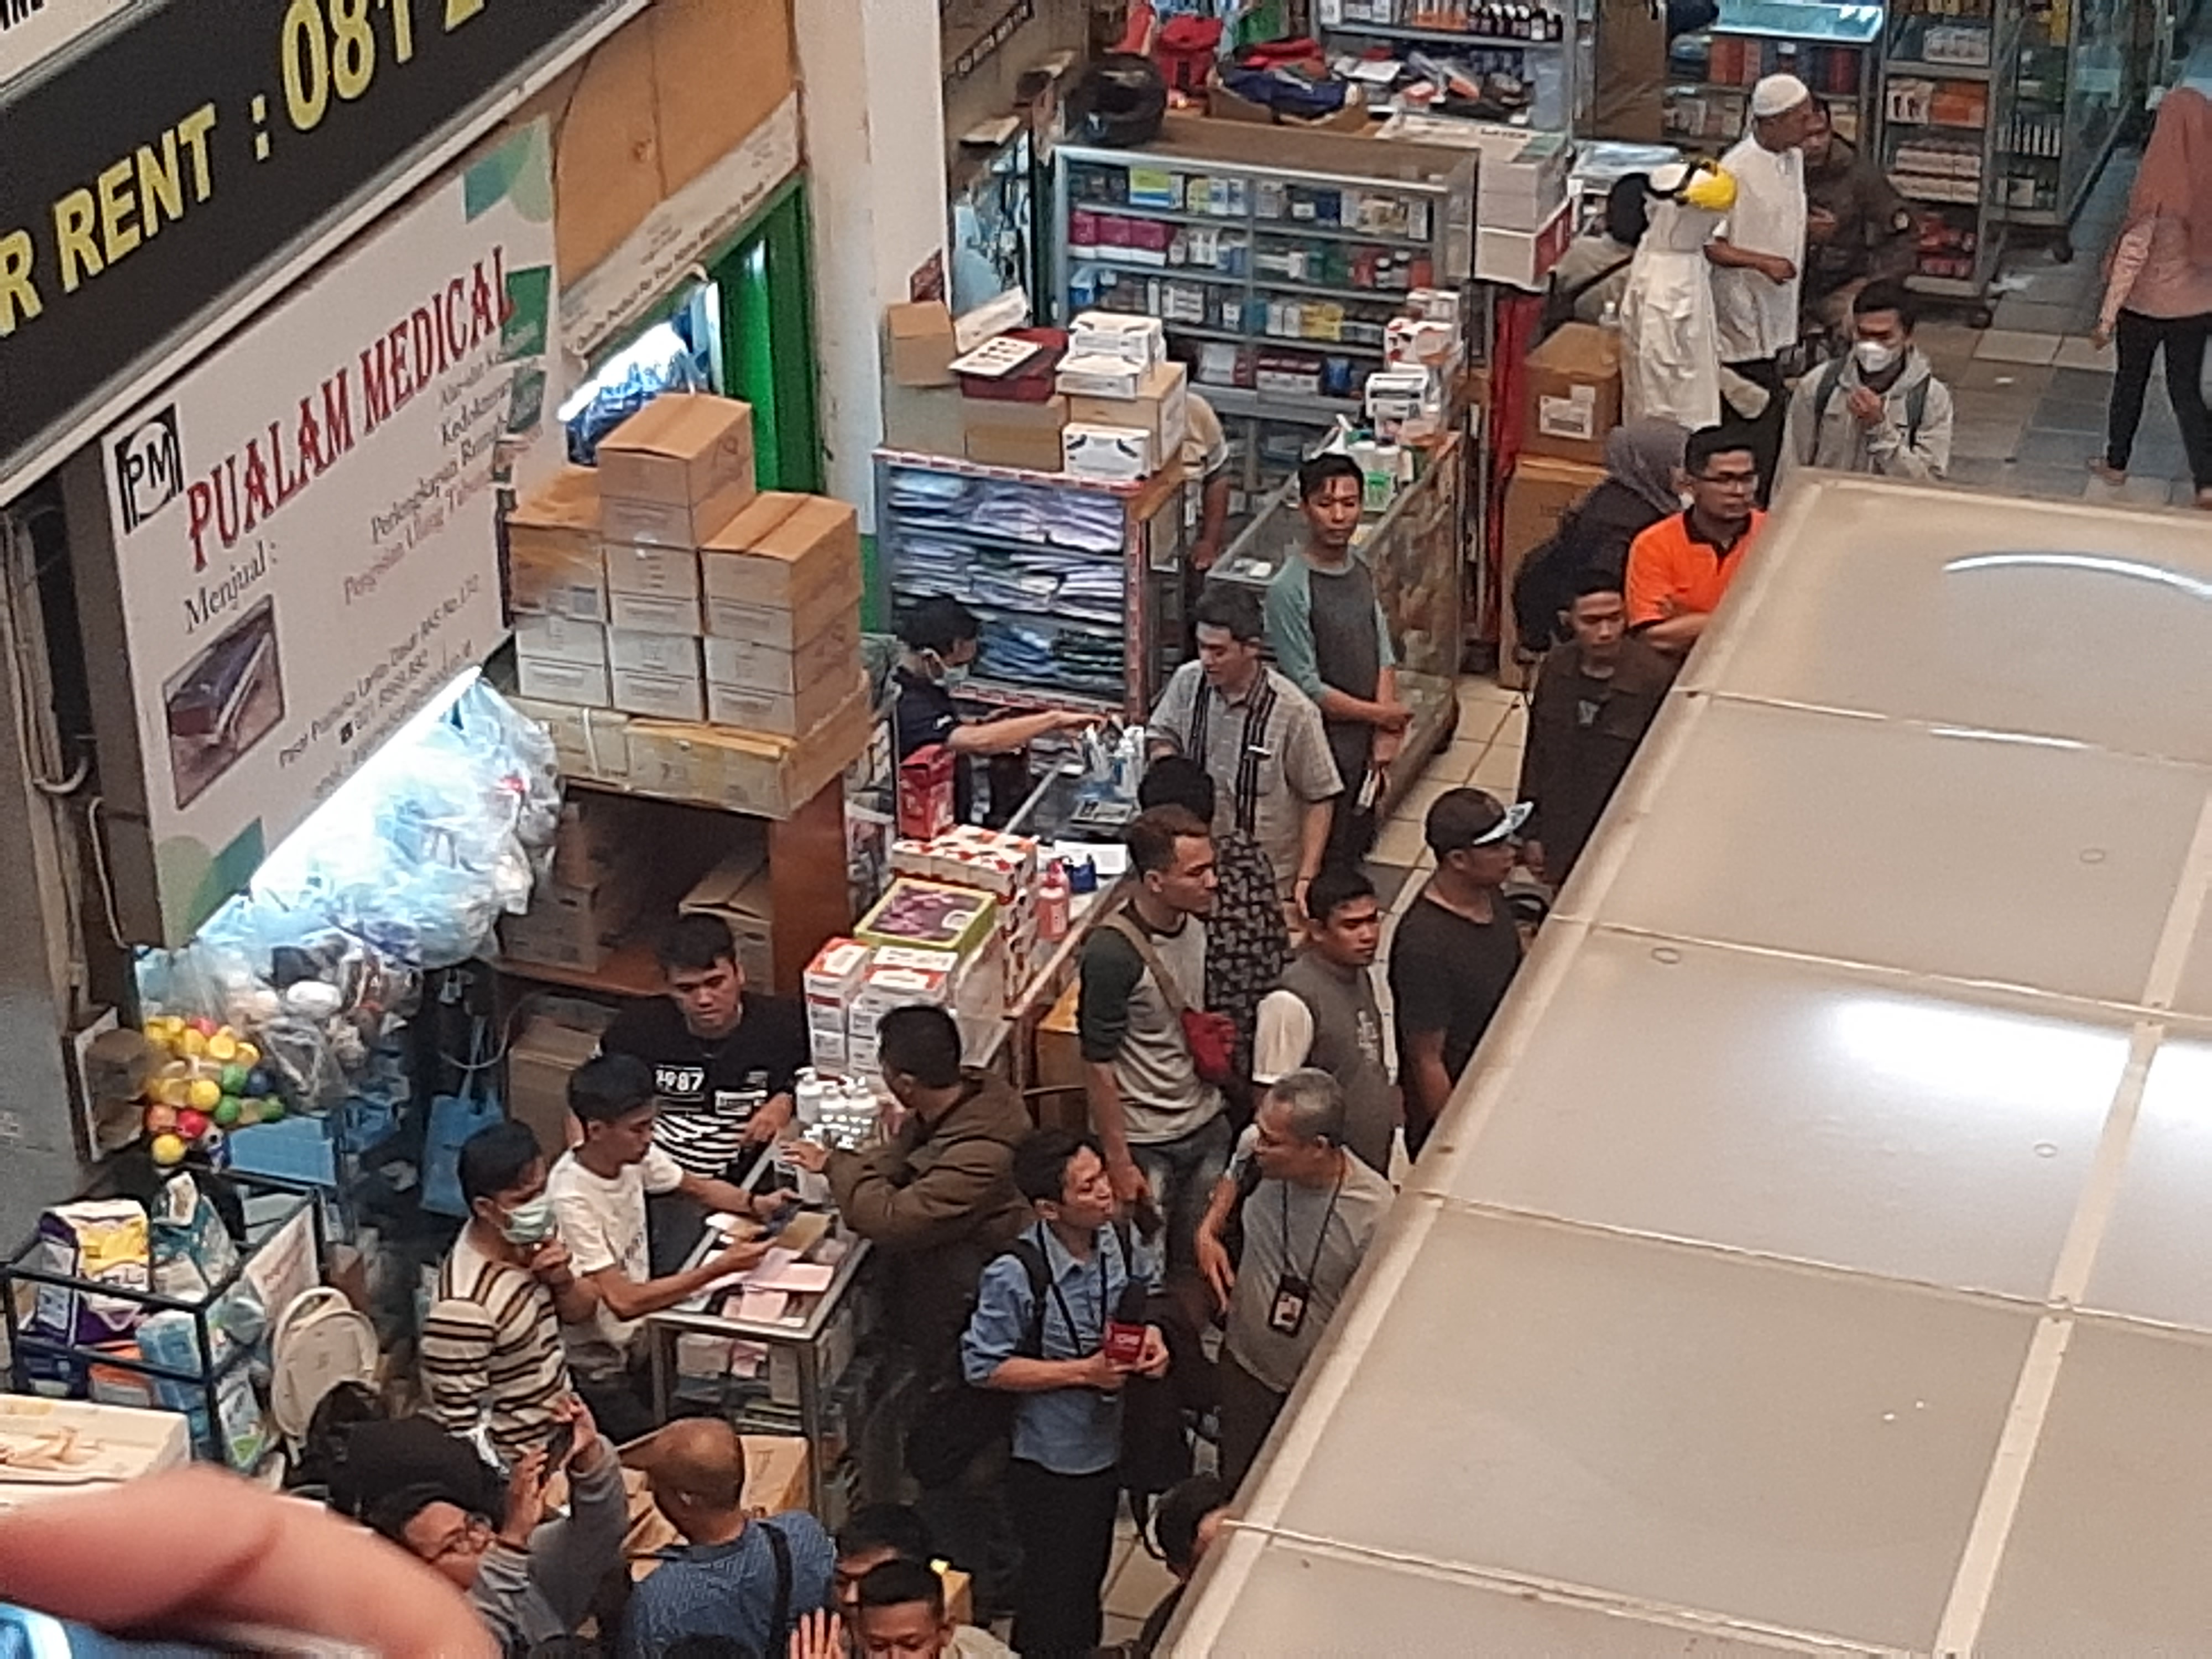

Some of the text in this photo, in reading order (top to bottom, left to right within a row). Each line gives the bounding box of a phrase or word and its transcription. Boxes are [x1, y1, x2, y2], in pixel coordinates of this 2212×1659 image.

[54, 102, 216, 294] RENT
[252, 93, 270, 161] :
[187, 244, 515, 573] PUALAM MEDICAL
[184, 539, 265, 635] Menjual
